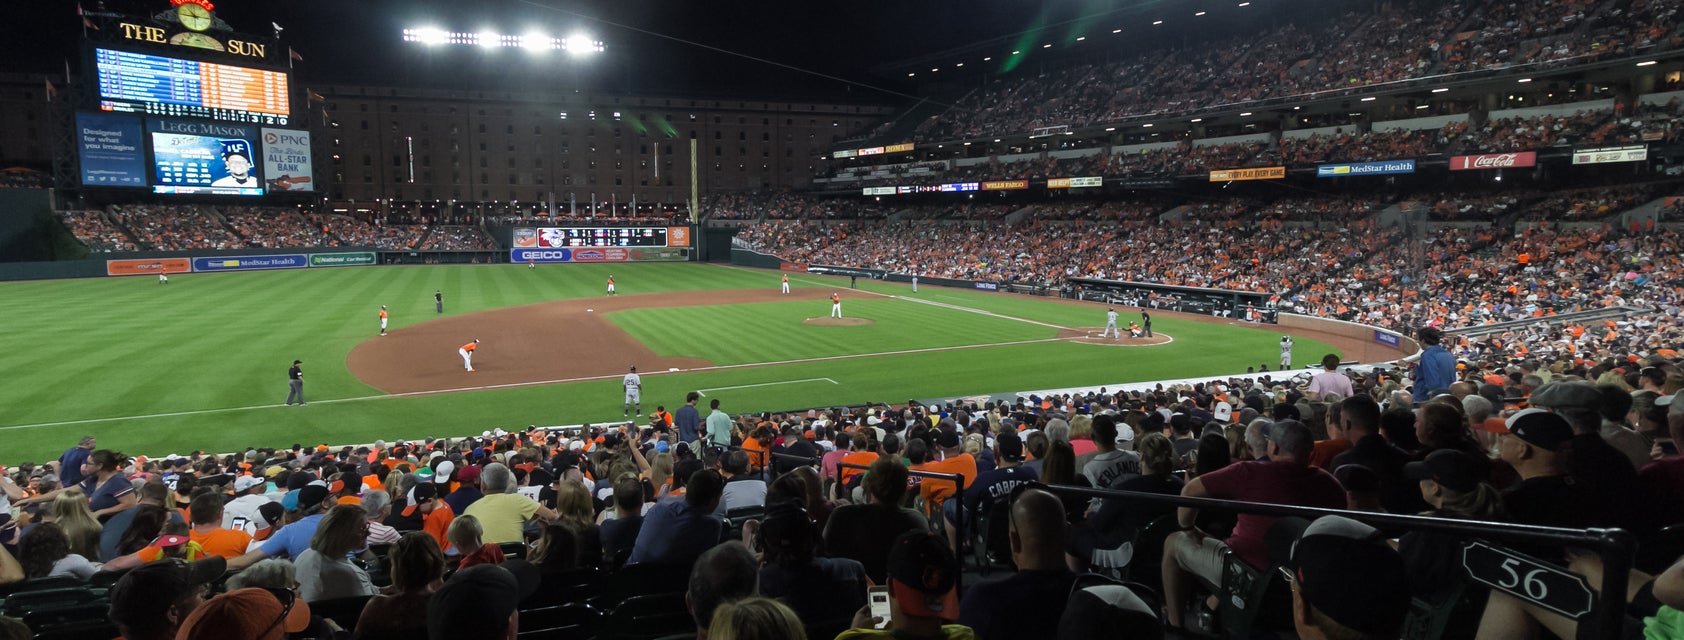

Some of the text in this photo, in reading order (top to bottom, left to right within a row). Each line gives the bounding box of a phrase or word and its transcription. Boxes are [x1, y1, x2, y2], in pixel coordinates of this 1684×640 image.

[120, 22, 264, 57] THE SUN
[251, 115, 259, 123] 3
[266, 117, 274, 125] 2
[83, 128, 122, 137] Designed
[160, 120, 246, 137] LEGG MASON
[98, 136, 119, 144] what
[280, 134, 308, 146] PNC
[103, 143, 136, 151] imagine
[268, 154, 307, 164] ALL-STAR
[277, 163, 299, 172] BANK
[1351, 163, 1413, 174] MedStar Health
[522, 251, 563, 259] GEICO
[1498, 558, 1549, 600] 56
